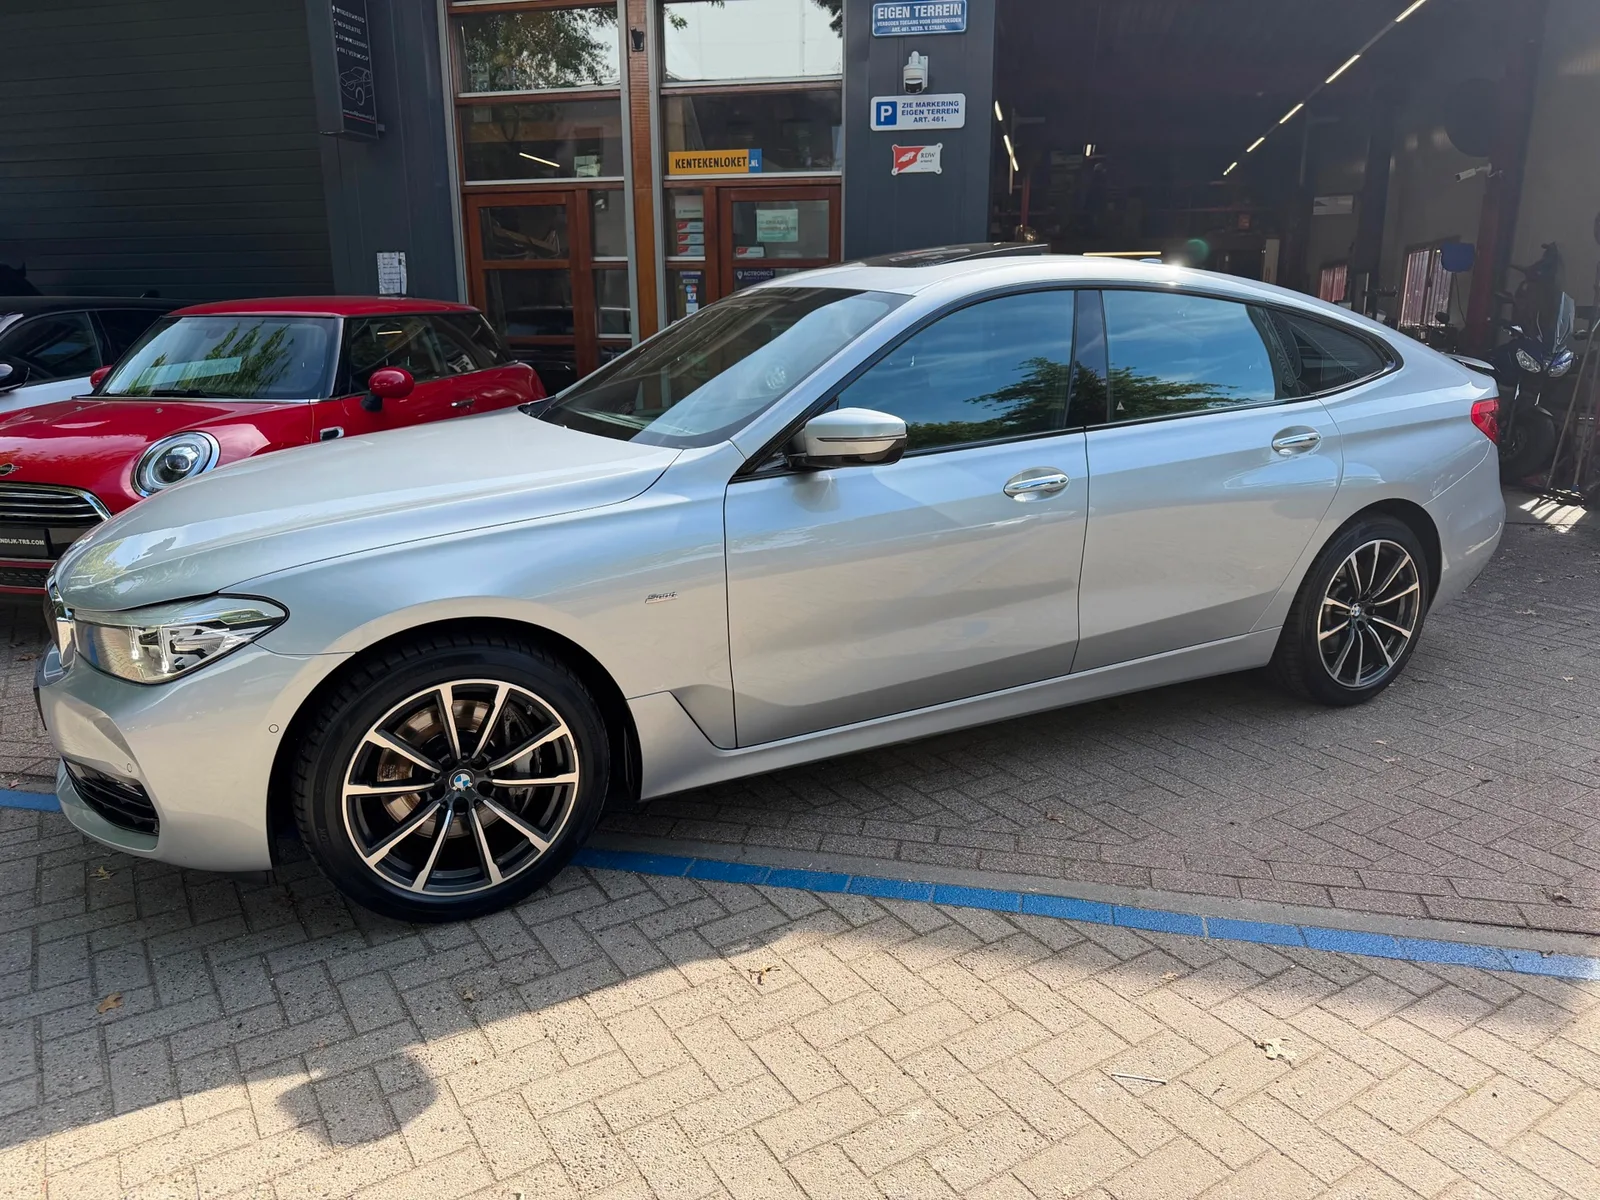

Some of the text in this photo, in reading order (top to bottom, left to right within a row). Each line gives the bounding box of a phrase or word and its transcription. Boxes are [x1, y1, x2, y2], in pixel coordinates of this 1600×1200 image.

[877, 3, 962, 19] EIGEN TERREIN
[880, 105, 893, 122] P
